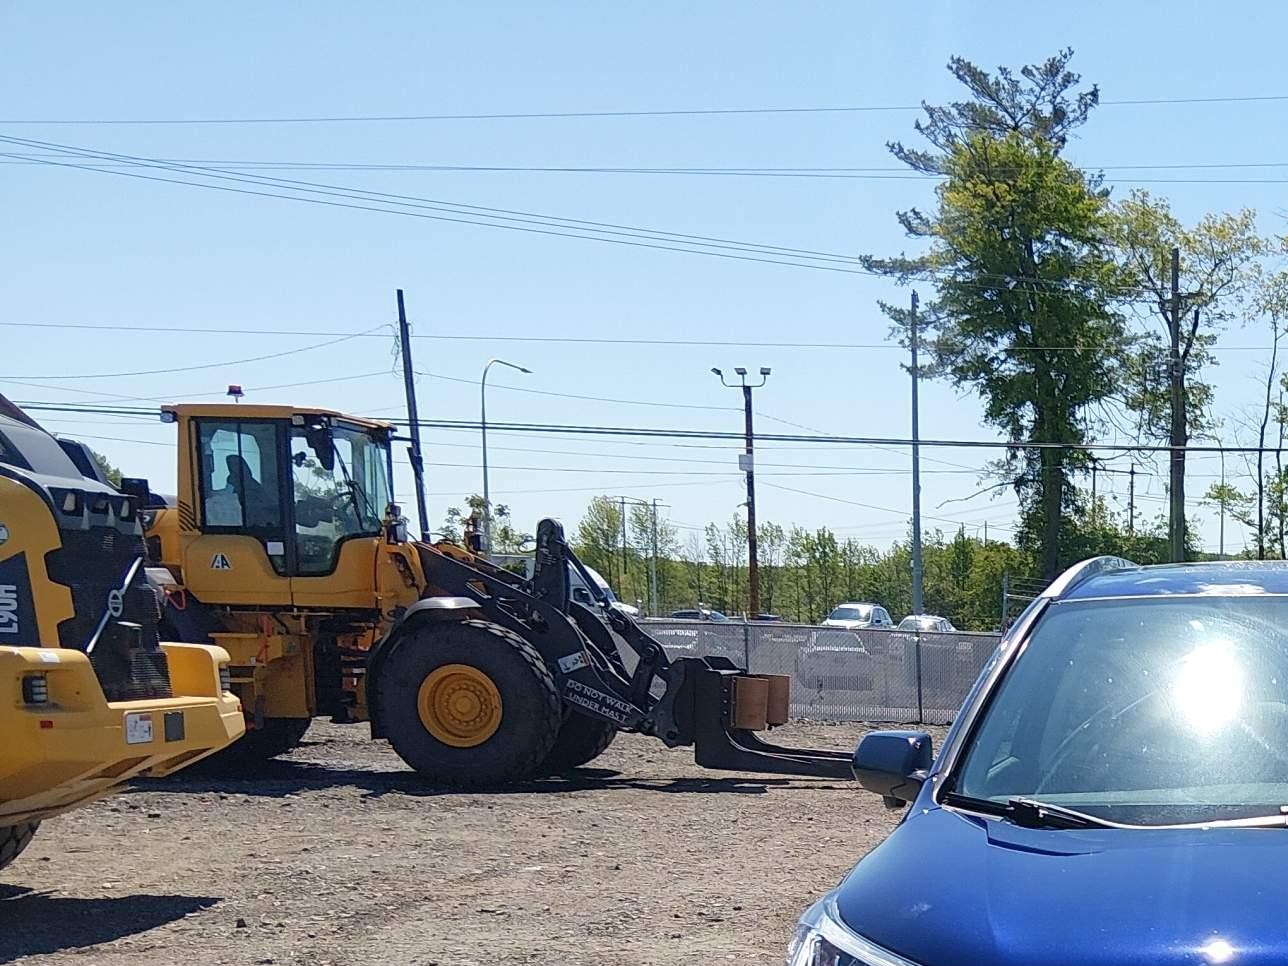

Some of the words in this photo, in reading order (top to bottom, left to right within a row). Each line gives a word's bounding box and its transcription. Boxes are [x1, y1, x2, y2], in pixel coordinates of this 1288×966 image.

[0, 584, 18, 633] L90H
[566, 679, 582, 691] DO
[583, 686, 605, 701] NOT
[605, 695, 634, 714] WALK
[568, 692, 600, 712] UNDER
[601, 706, 628, 722] MAST
